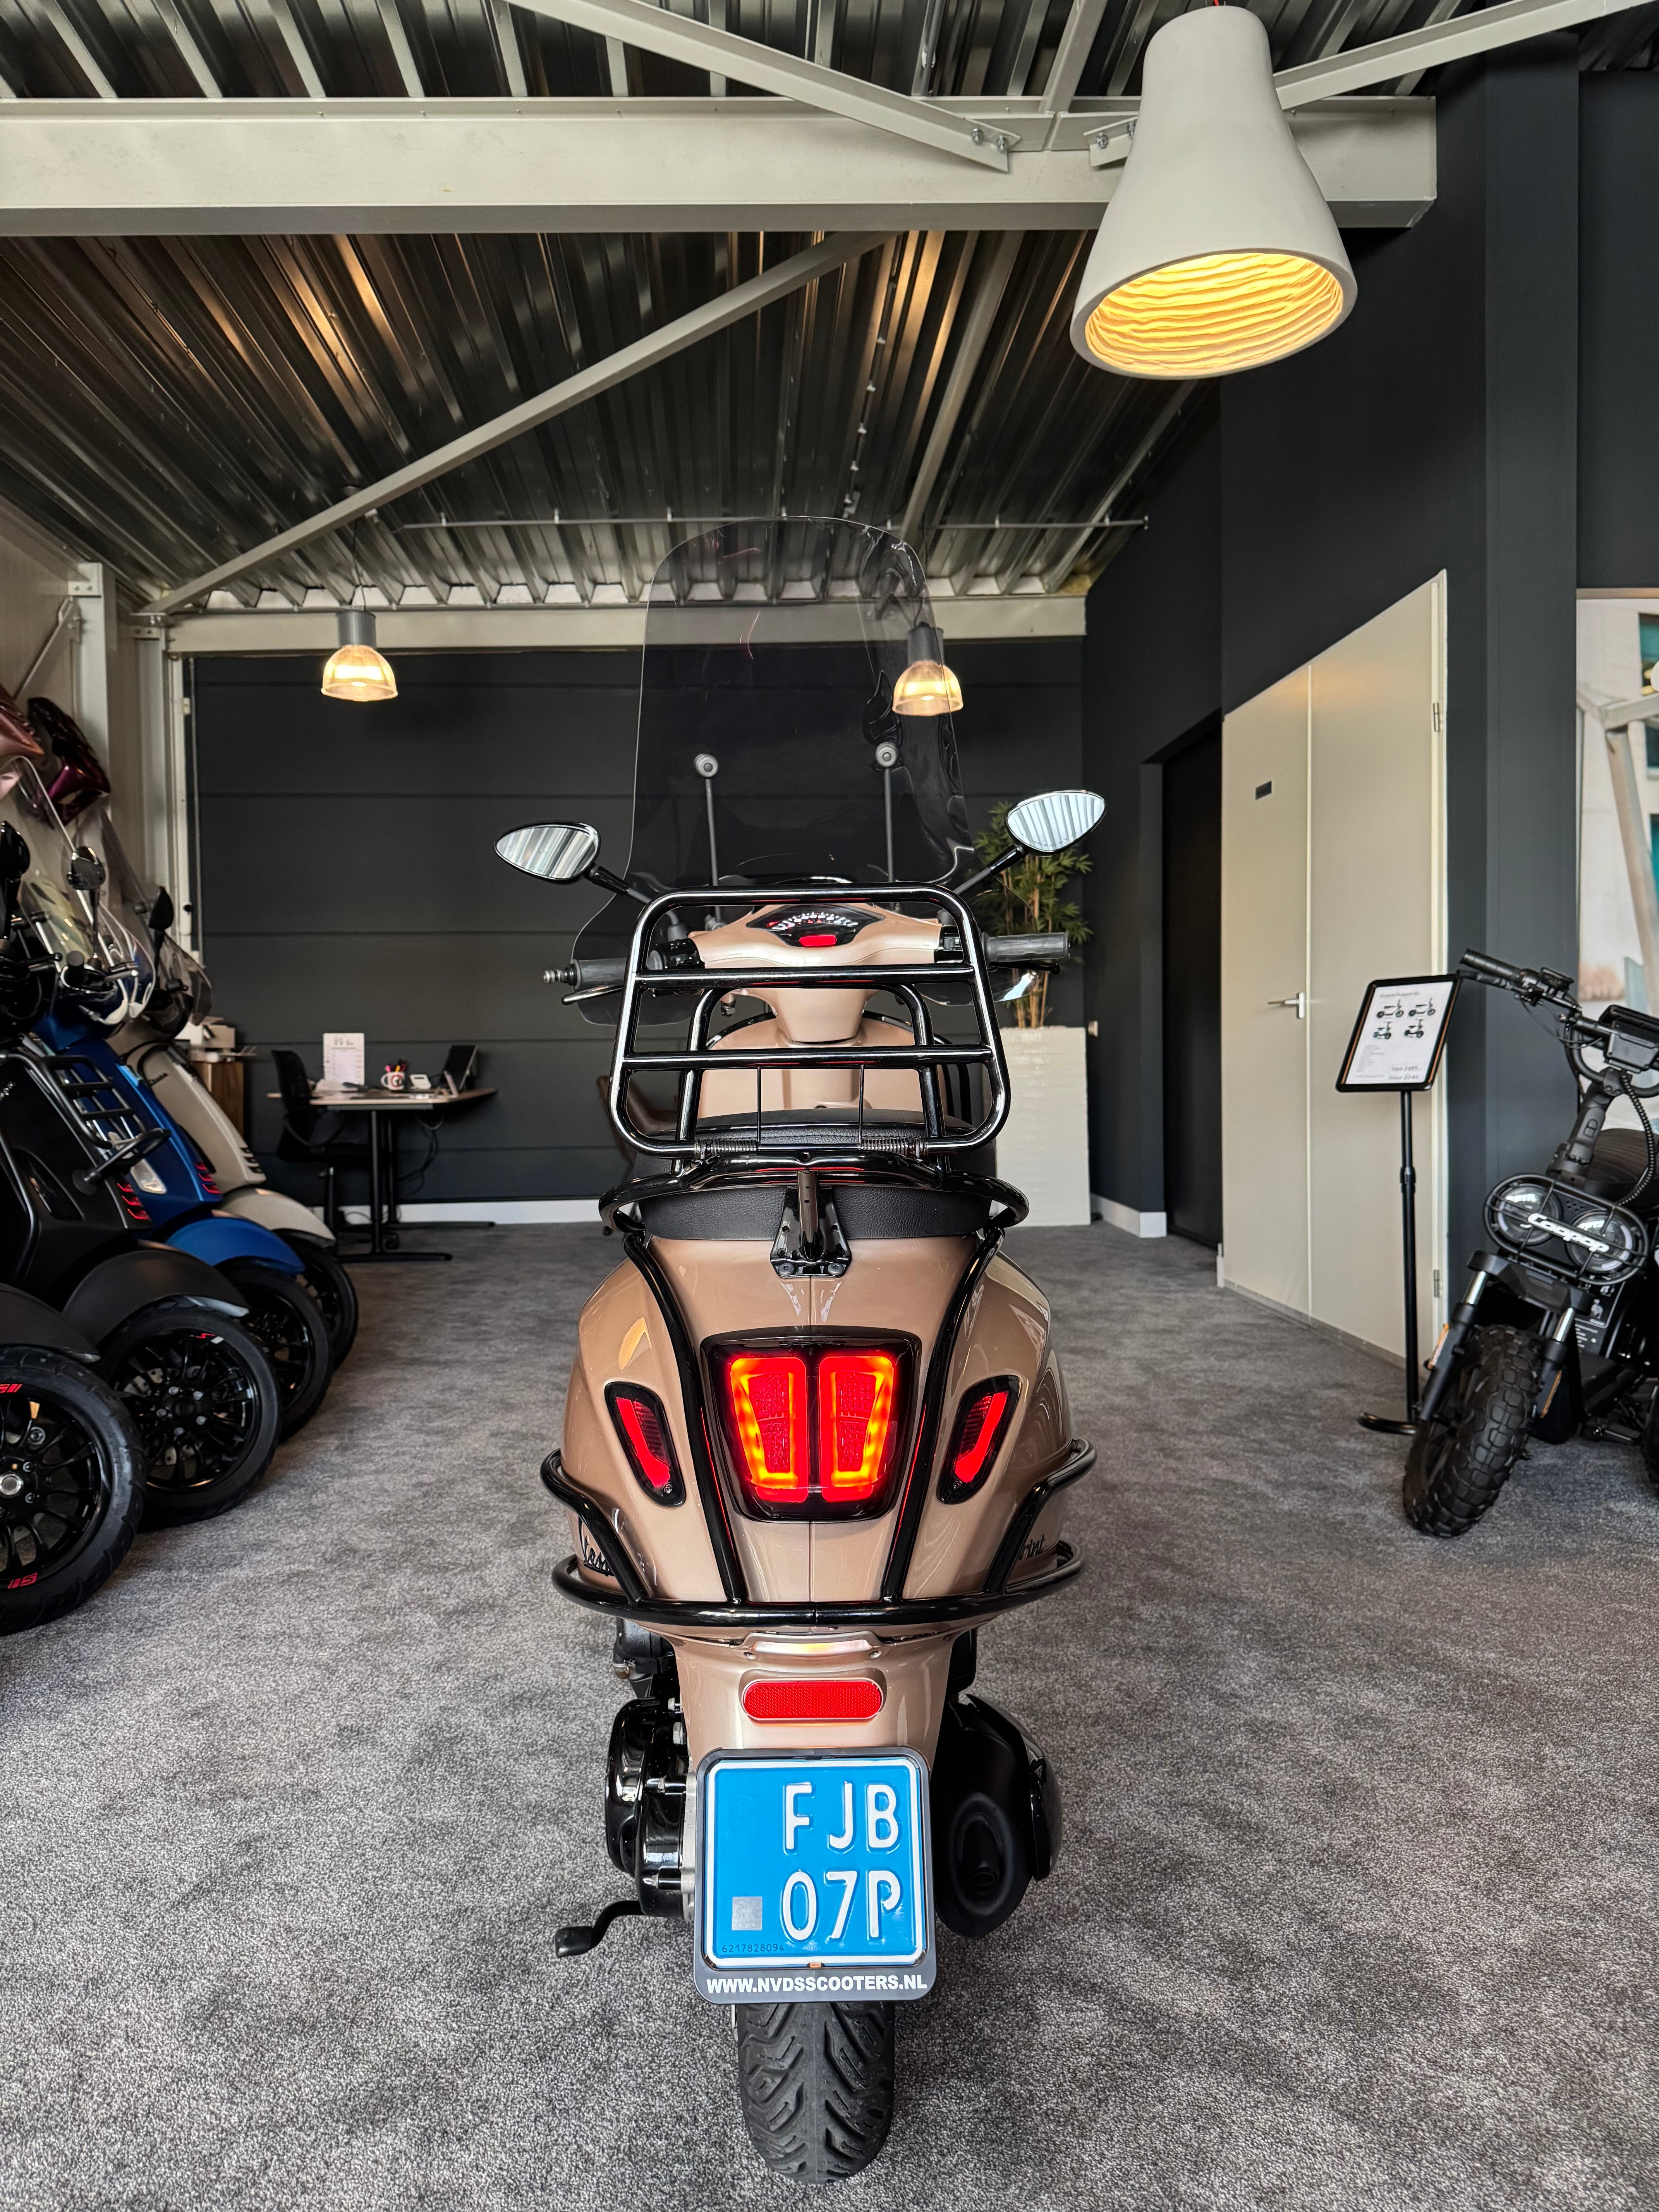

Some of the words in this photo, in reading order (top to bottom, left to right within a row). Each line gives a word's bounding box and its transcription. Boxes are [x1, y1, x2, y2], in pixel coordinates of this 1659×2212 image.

[785, 1782, 899, 1850] FJB
[782, 1870, 901, 1941] 07P
[722, 1944, 785, 1953] 6217828094
[706, 1975, 927, 1994] WWW.NVDSSCOOTERS.NL
